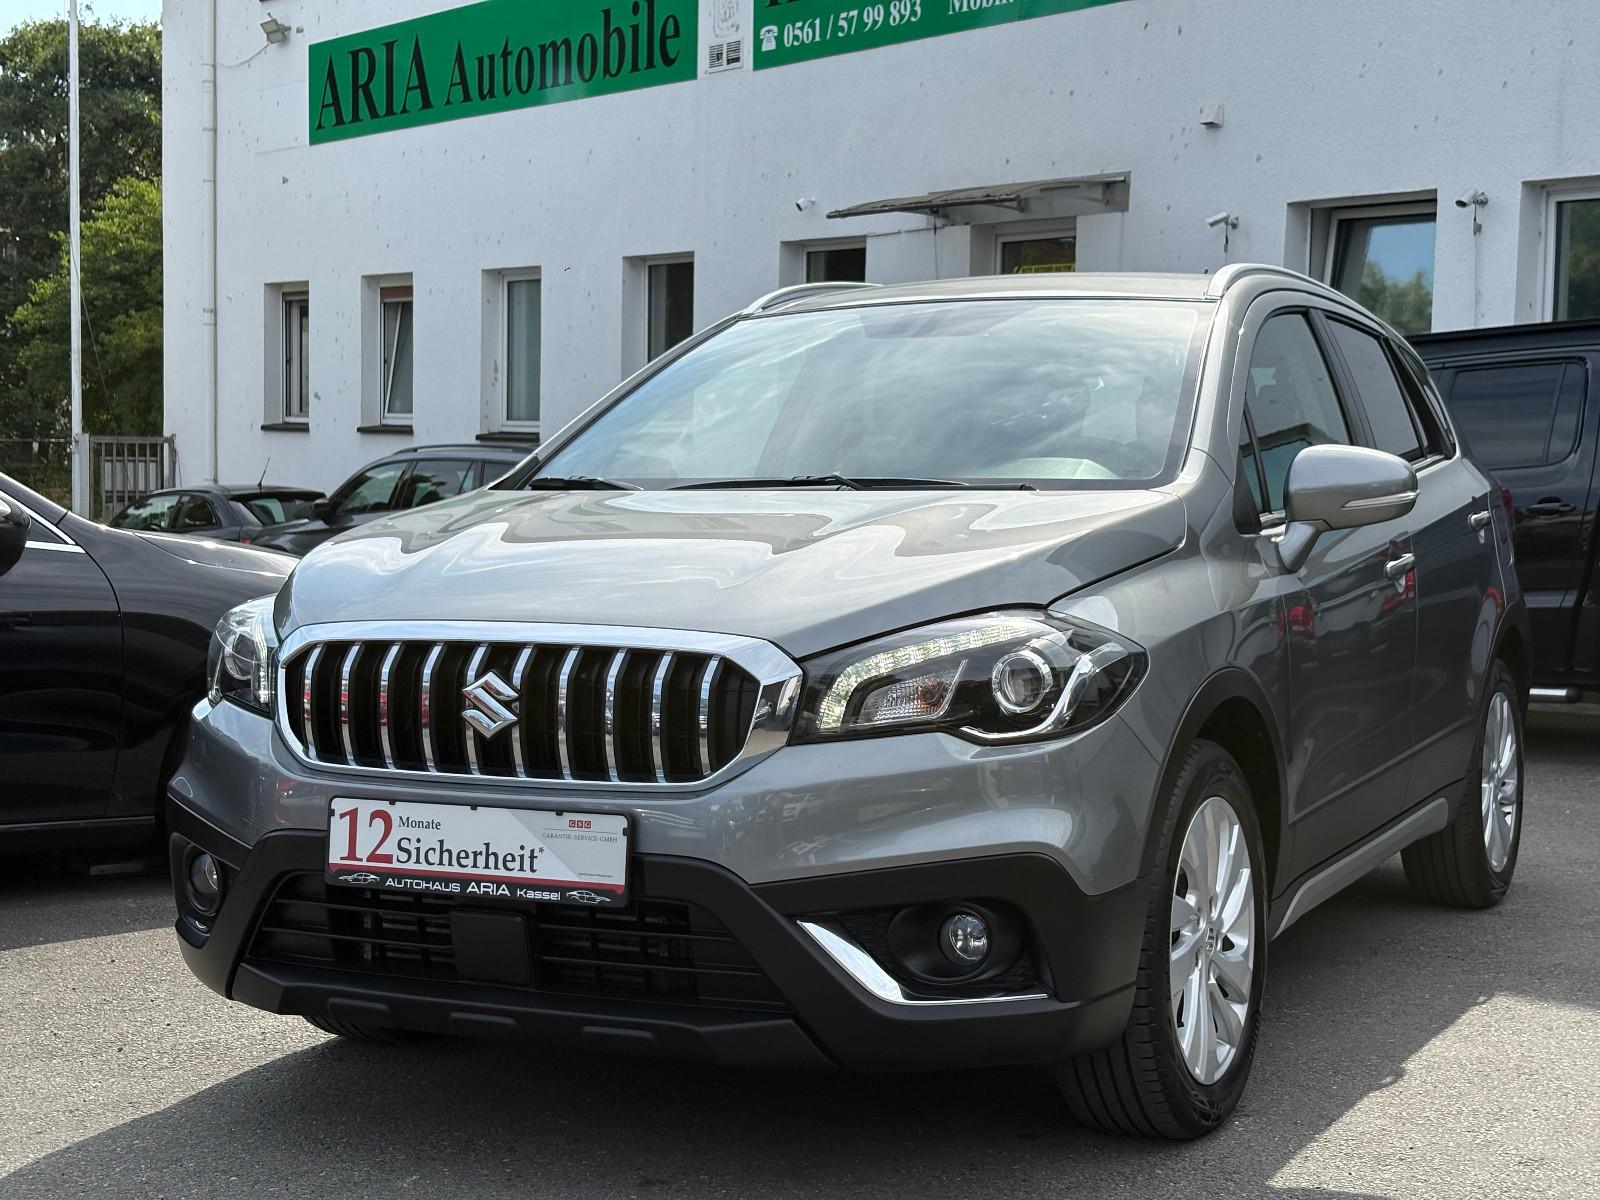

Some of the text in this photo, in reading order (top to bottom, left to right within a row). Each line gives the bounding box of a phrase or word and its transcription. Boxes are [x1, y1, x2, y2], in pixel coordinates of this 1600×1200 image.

[783, 18, 822, 48] 0561
[826, 14, 834, 40] /
[837, 9, 859, 37] 57
[862, 5, 884, 33] 99
[889, 0, 922, 27] 893
[315, 0, 681, 130] ARIA Automobile
[339, 806, 394, 864] 12
[398, 815, 441, 830] Monate
[385, 877, 561, 901] AUTOHAUS ARIA Kassel
